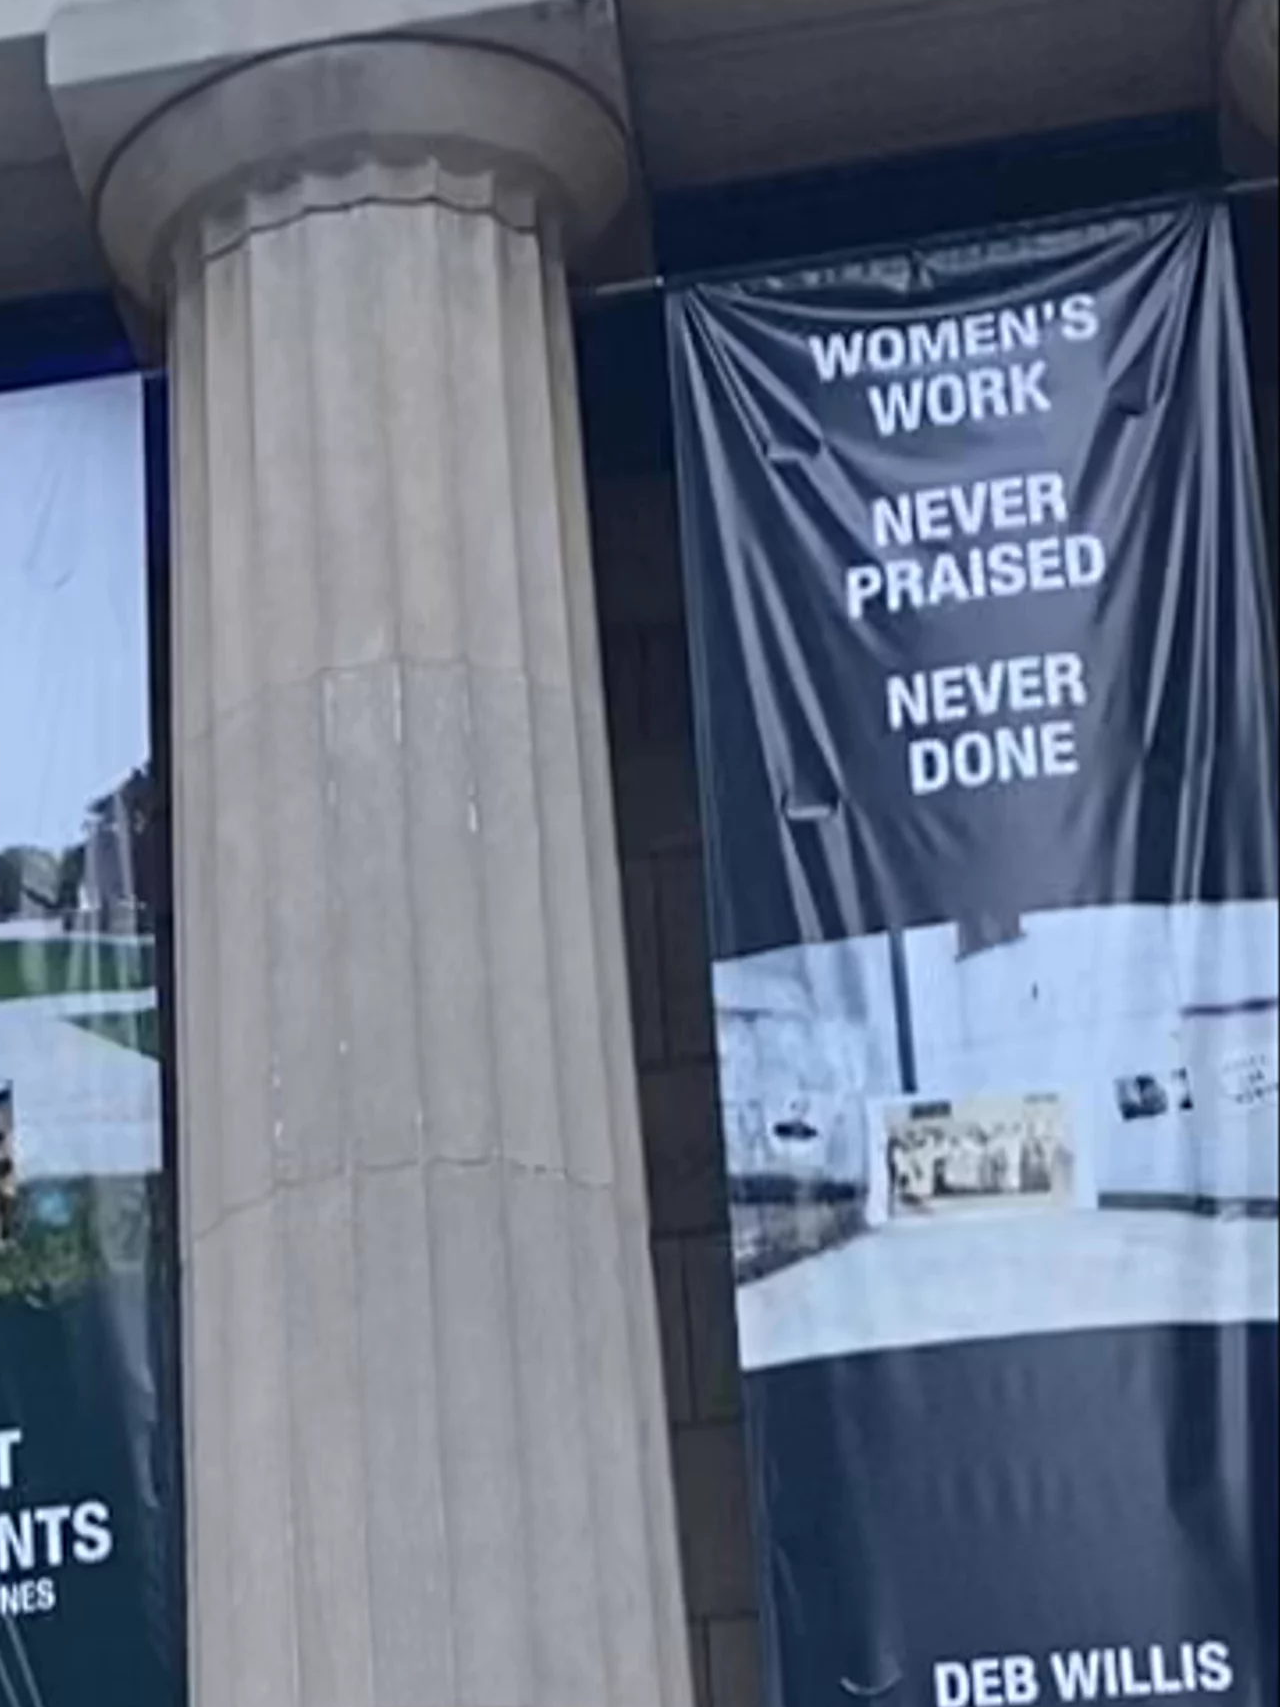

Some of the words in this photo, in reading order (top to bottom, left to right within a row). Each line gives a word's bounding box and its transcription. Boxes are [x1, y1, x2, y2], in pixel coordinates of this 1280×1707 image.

[810, 295, 1100, 382] WOMEN'S
[868, 359, 1051, 437] WORK
[871, 471, 1067, 547] NEVER
[845, 533, 1106, 620] PRAISED
[886, 651, 1087, 730] NEVER
[909, 721, 1078, 796] DONE
[1049, 1641, 1232, 1700] WILLIS
